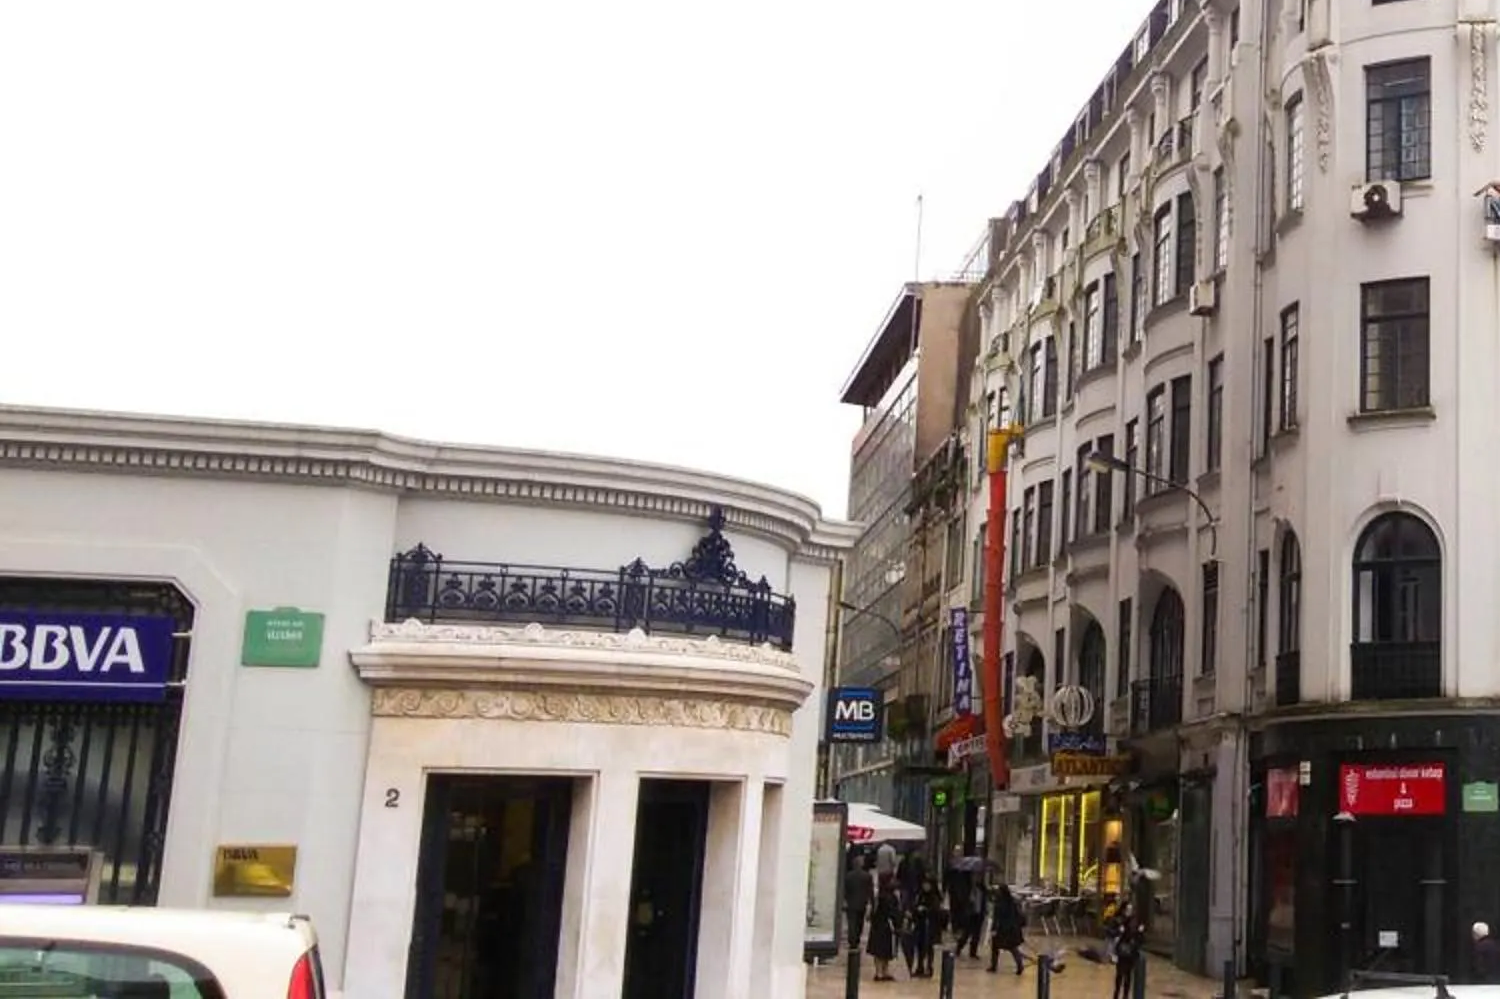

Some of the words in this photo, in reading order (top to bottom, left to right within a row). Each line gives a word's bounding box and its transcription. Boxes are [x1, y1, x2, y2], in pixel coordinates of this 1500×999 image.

[0, 624, 145, 672] BBVA
[953, 612, 970, 709] RETINA
[835, 700, 875, 720] MB
[385, 788, 400, 807] 2
